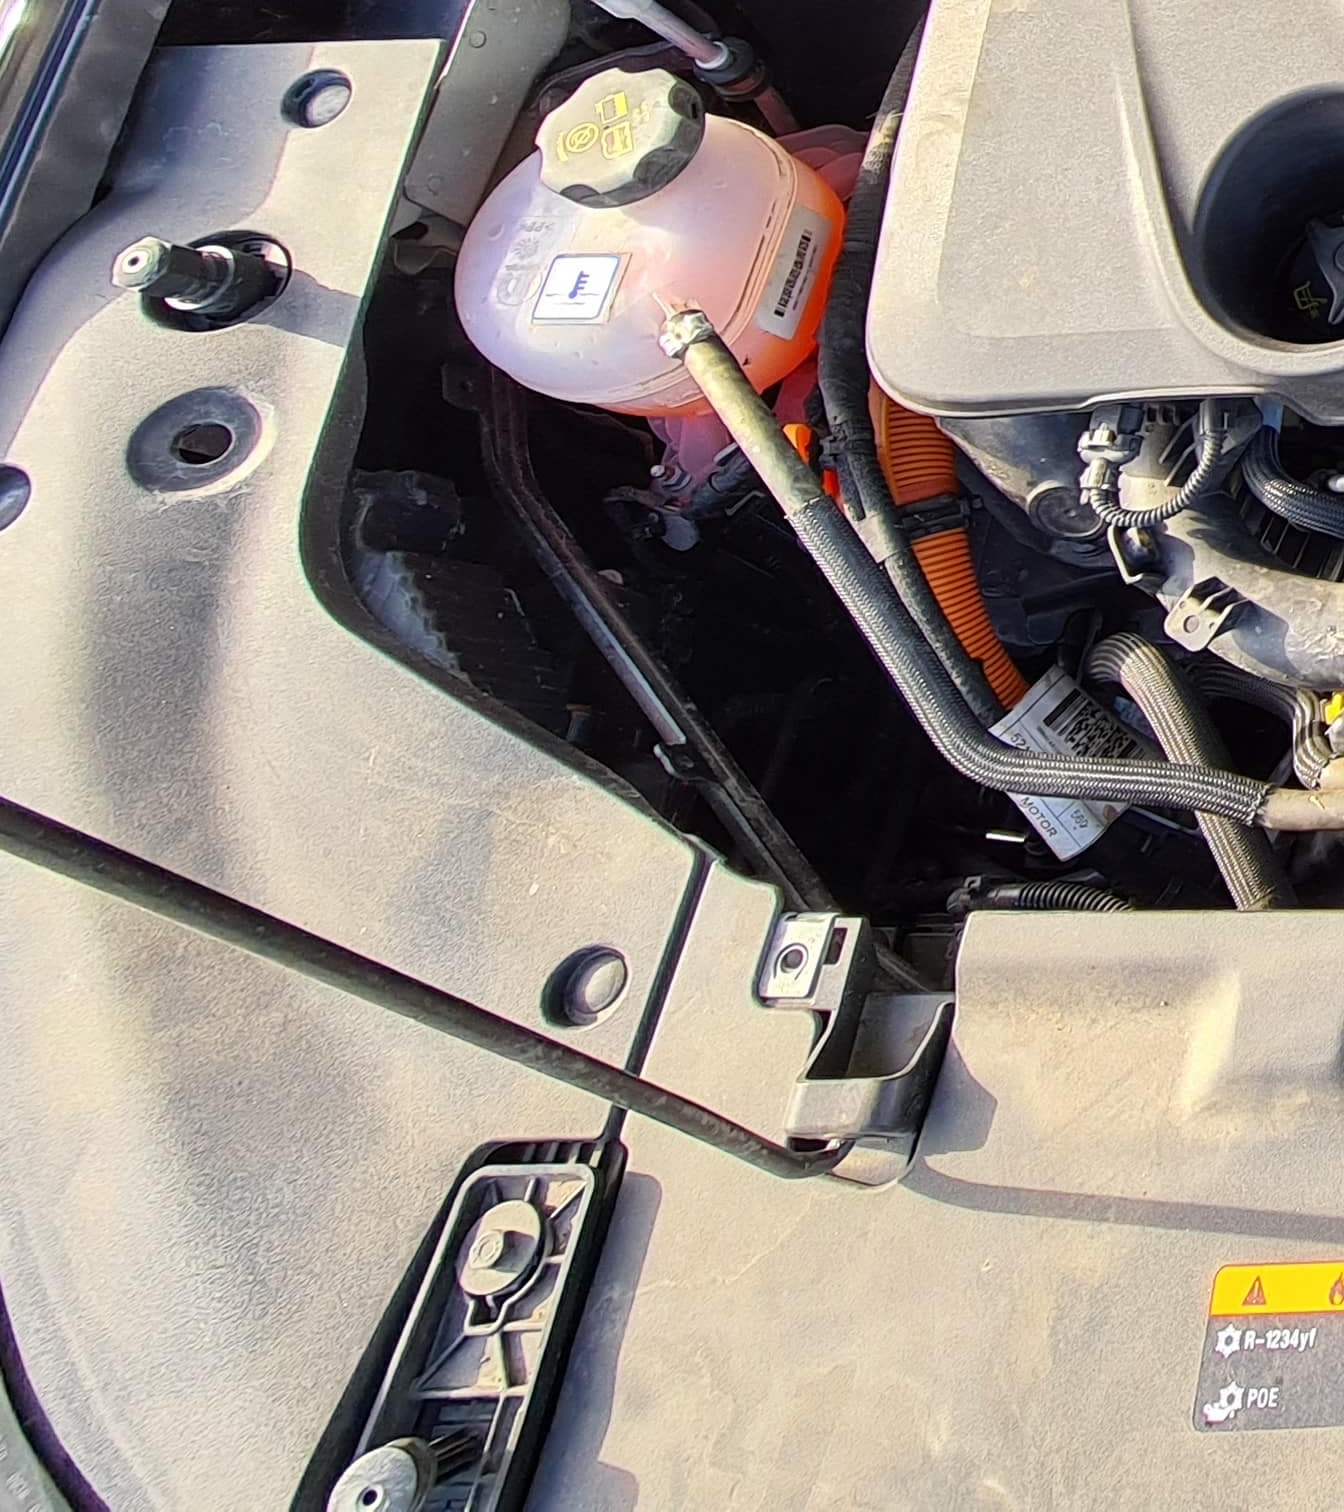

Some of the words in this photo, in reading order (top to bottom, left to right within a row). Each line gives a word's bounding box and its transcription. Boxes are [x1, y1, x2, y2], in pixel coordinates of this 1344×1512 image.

[1020, 795, 1059, 838] MOTOR
[1243, 1326, 1317, 1352] R-1234yf
[1247, 1387, 1279, 1409] POE
